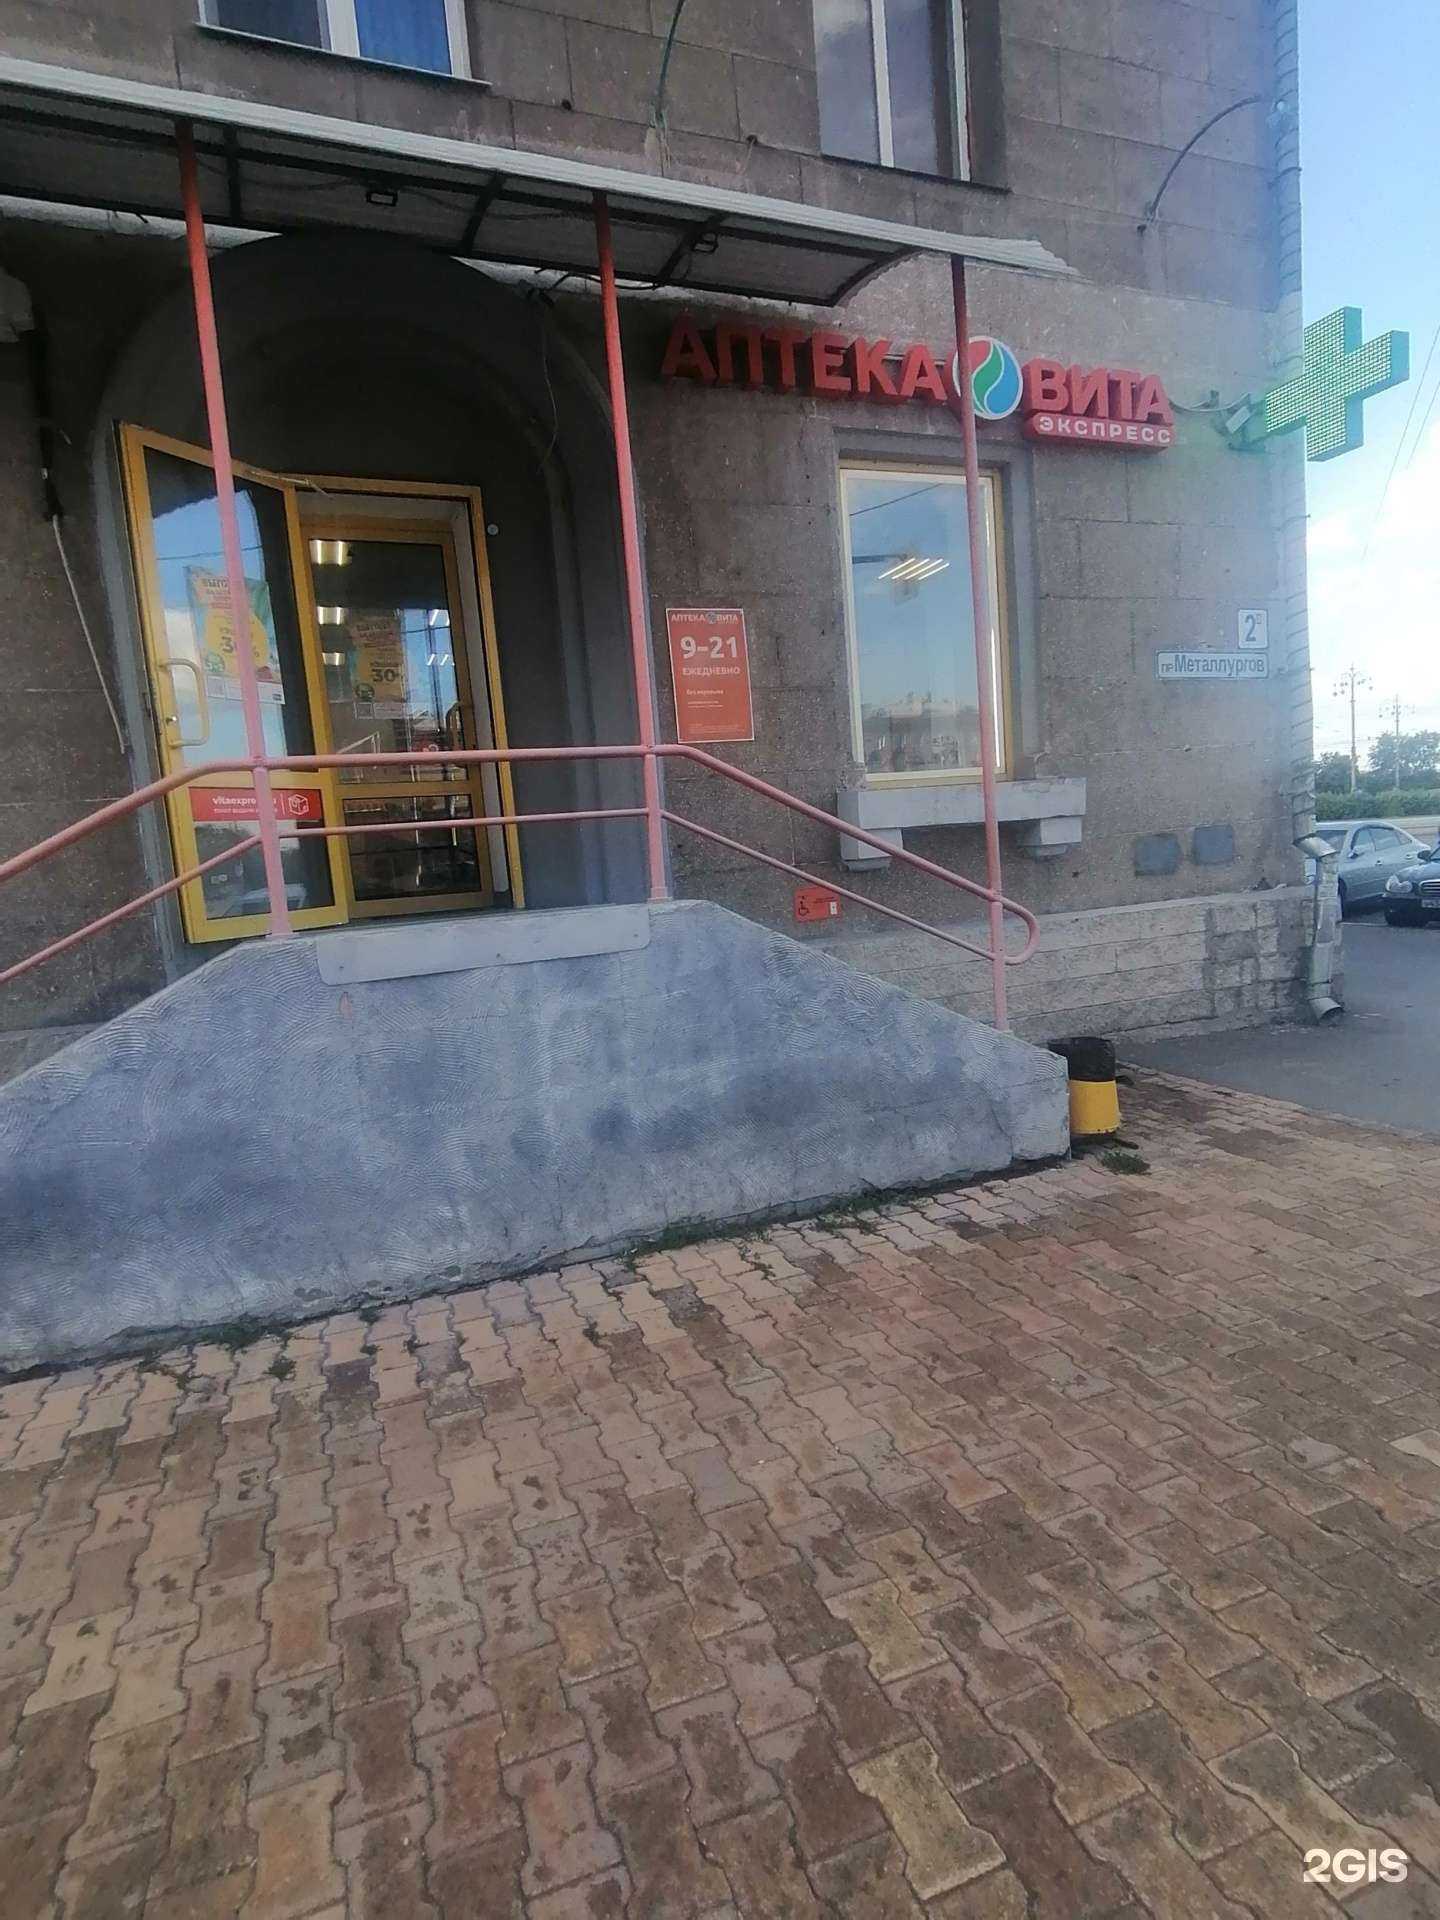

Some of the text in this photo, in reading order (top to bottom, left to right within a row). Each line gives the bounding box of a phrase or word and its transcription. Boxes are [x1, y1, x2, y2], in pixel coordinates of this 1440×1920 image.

[661, 312, 1174, 425] АПТЕКА ВИТА
[1039, 416, 1171, 443] ЭКСПРЕСС
[671, 614, 706, 622] АПТЕКА
[680, 636, 738, 659] 9-21
[682, 666, 741, 676] ЕЖЕДНЕВНО
[1174, 654, 1265, 677] Металлургов
